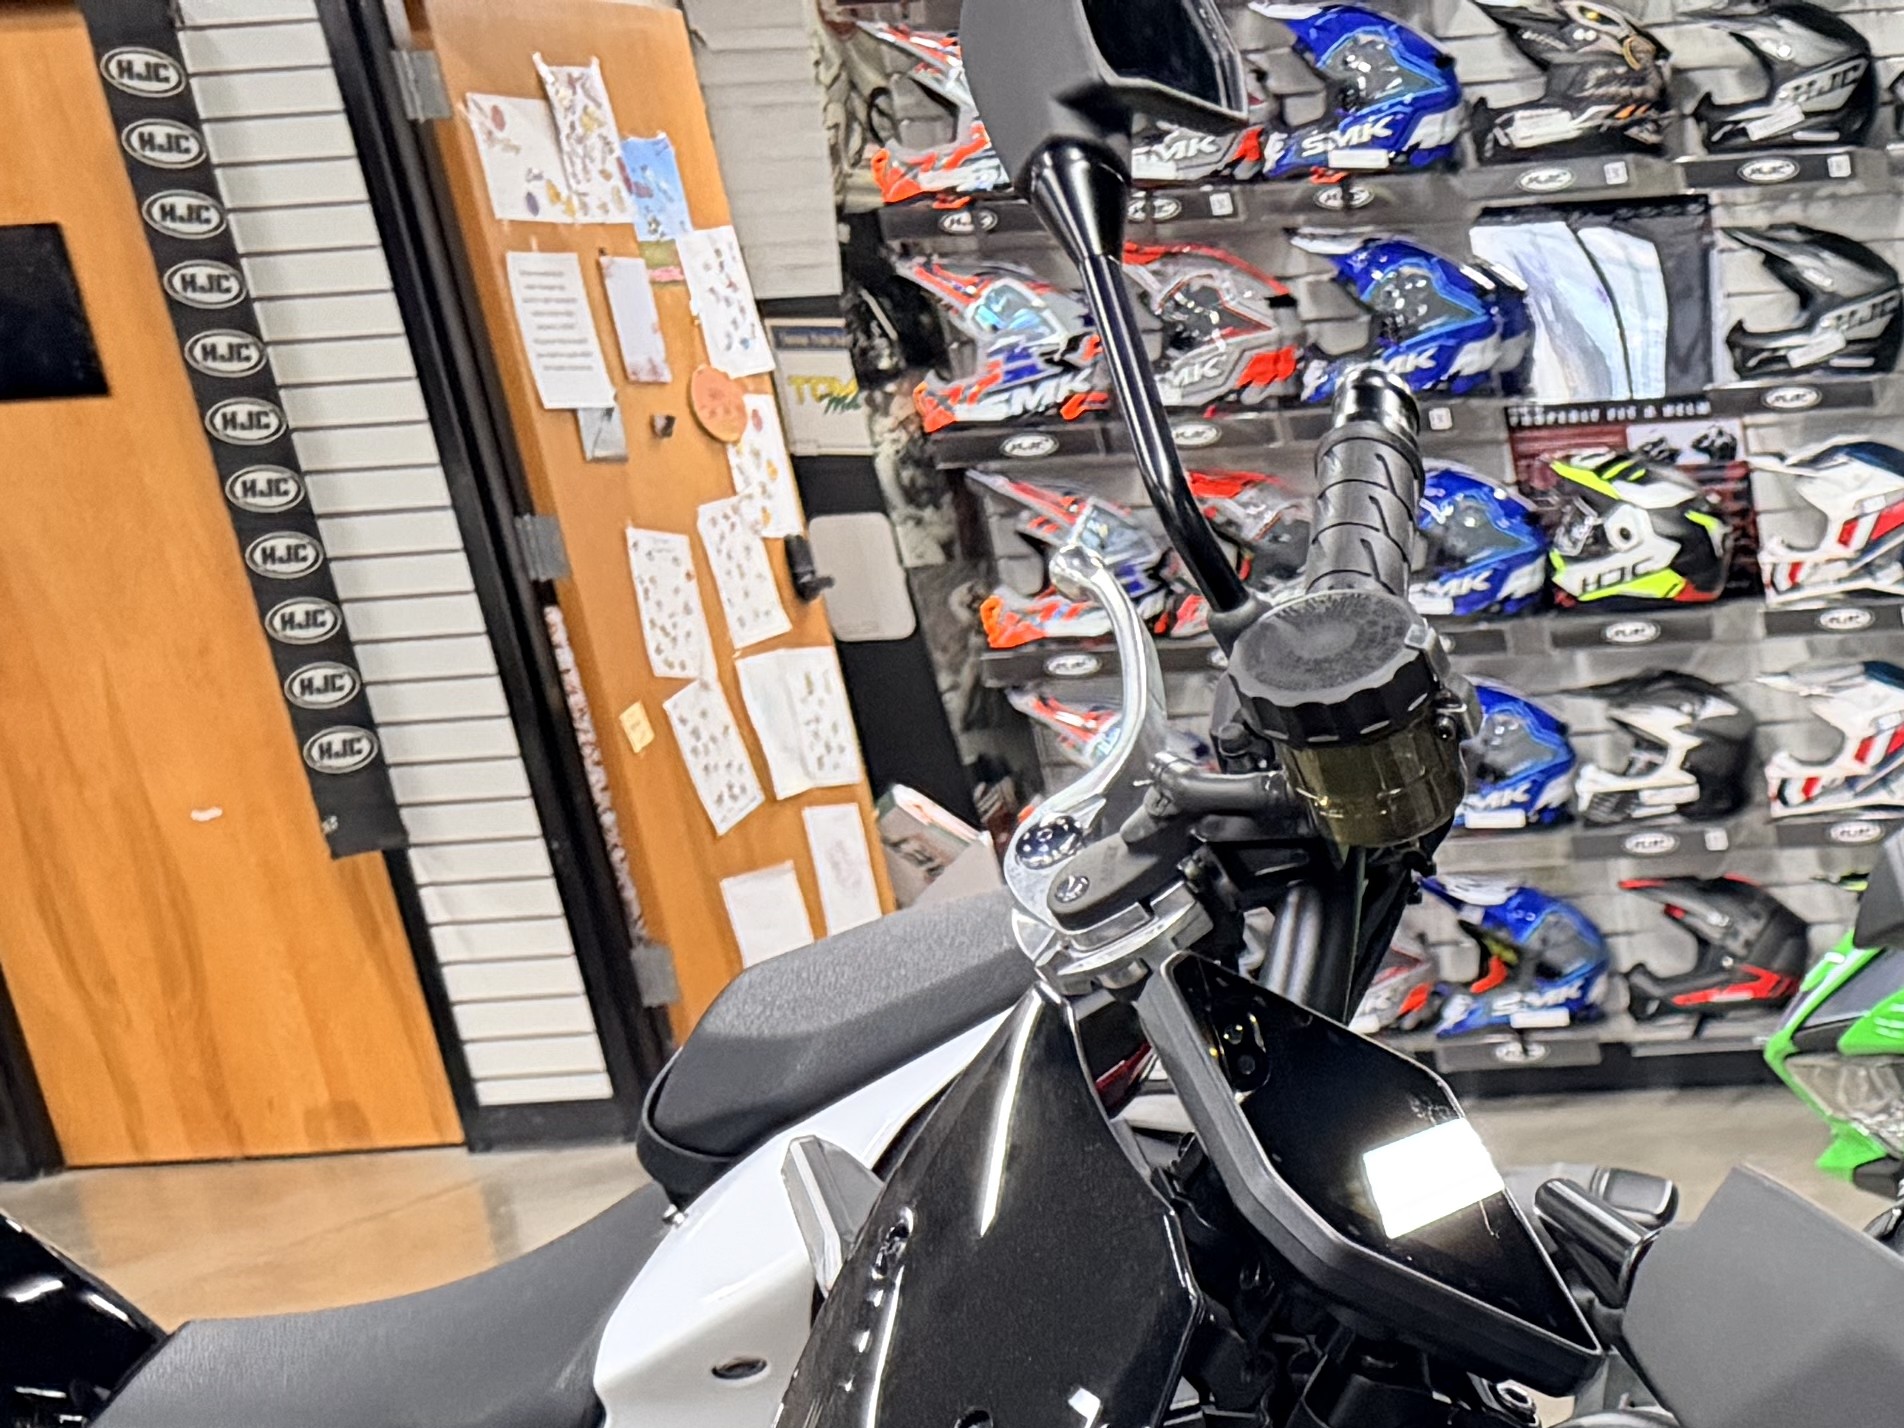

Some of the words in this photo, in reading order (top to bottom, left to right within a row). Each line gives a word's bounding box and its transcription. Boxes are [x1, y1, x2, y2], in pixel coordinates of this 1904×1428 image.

[115, 59, 170, 84] HJC
[138, 131, 192, 155] HJC
[1301, 114, 1395, 158] SMK
[159, 203, 212, 225] HJC
[180, 272, 232, 295] HJC
[201, 342, 253, 363] HJC
[221, 410, 272, 432] HJC
[241, 478, 291, 499] HJC
[261, 544, 309, 565] HJC
[280, 609, 328, 631] HJC
[299, 674, 346, 696] HJC
[318, 738, 365, 760] HJC
